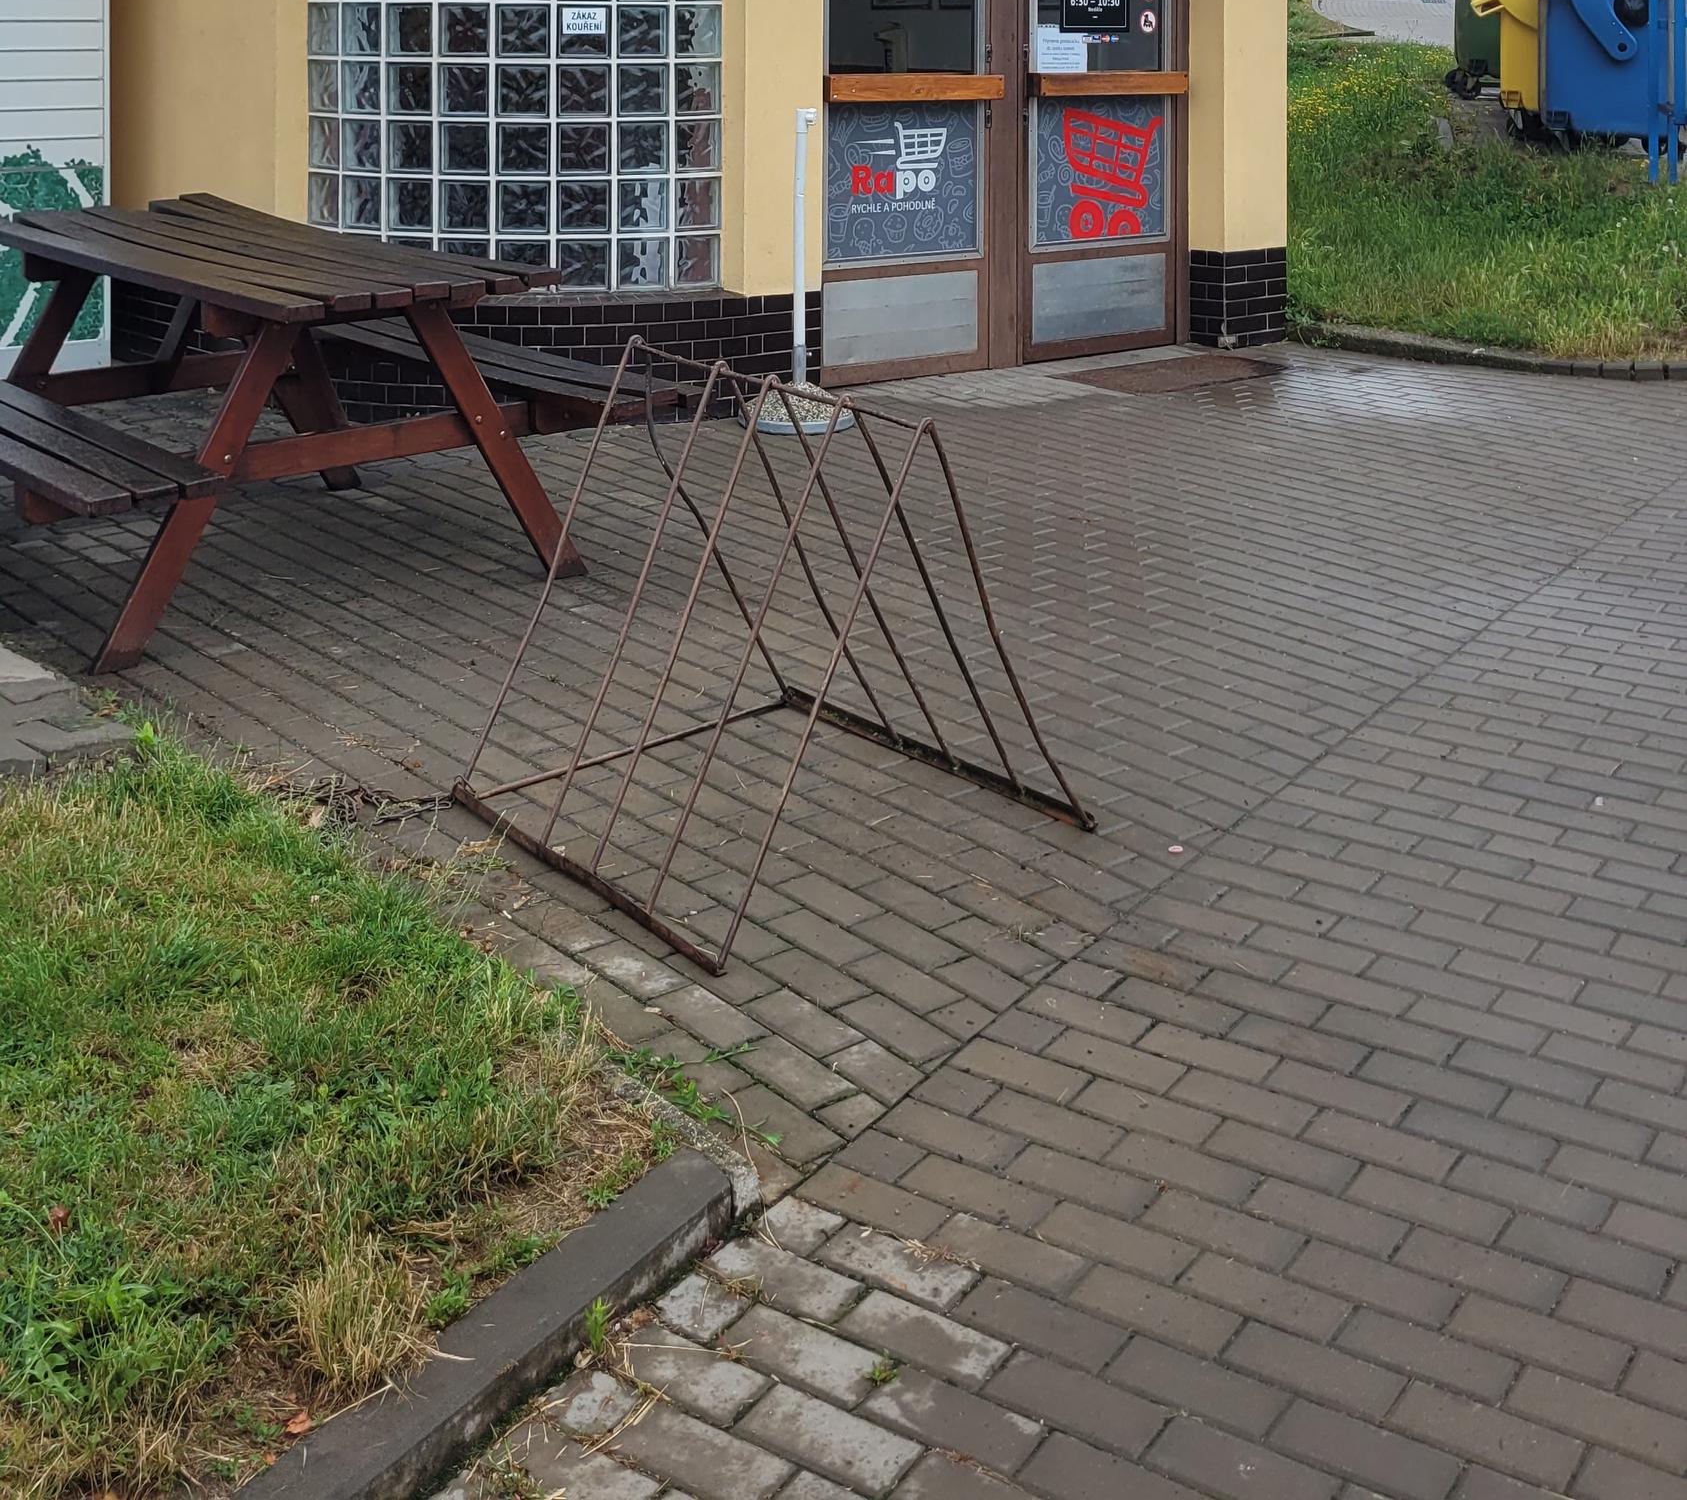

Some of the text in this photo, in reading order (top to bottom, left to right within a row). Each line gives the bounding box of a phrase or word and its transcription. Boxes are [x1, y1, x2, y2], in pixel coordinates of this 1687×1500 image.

[571, 10, 597, 20] ZÁKAZ
[566, 21, 602, 31] KOUŘENÍ
[851, 164, 936, 200] Rapo
[851, 198, 936, 214] RYCHLE A POHODLNĚ
